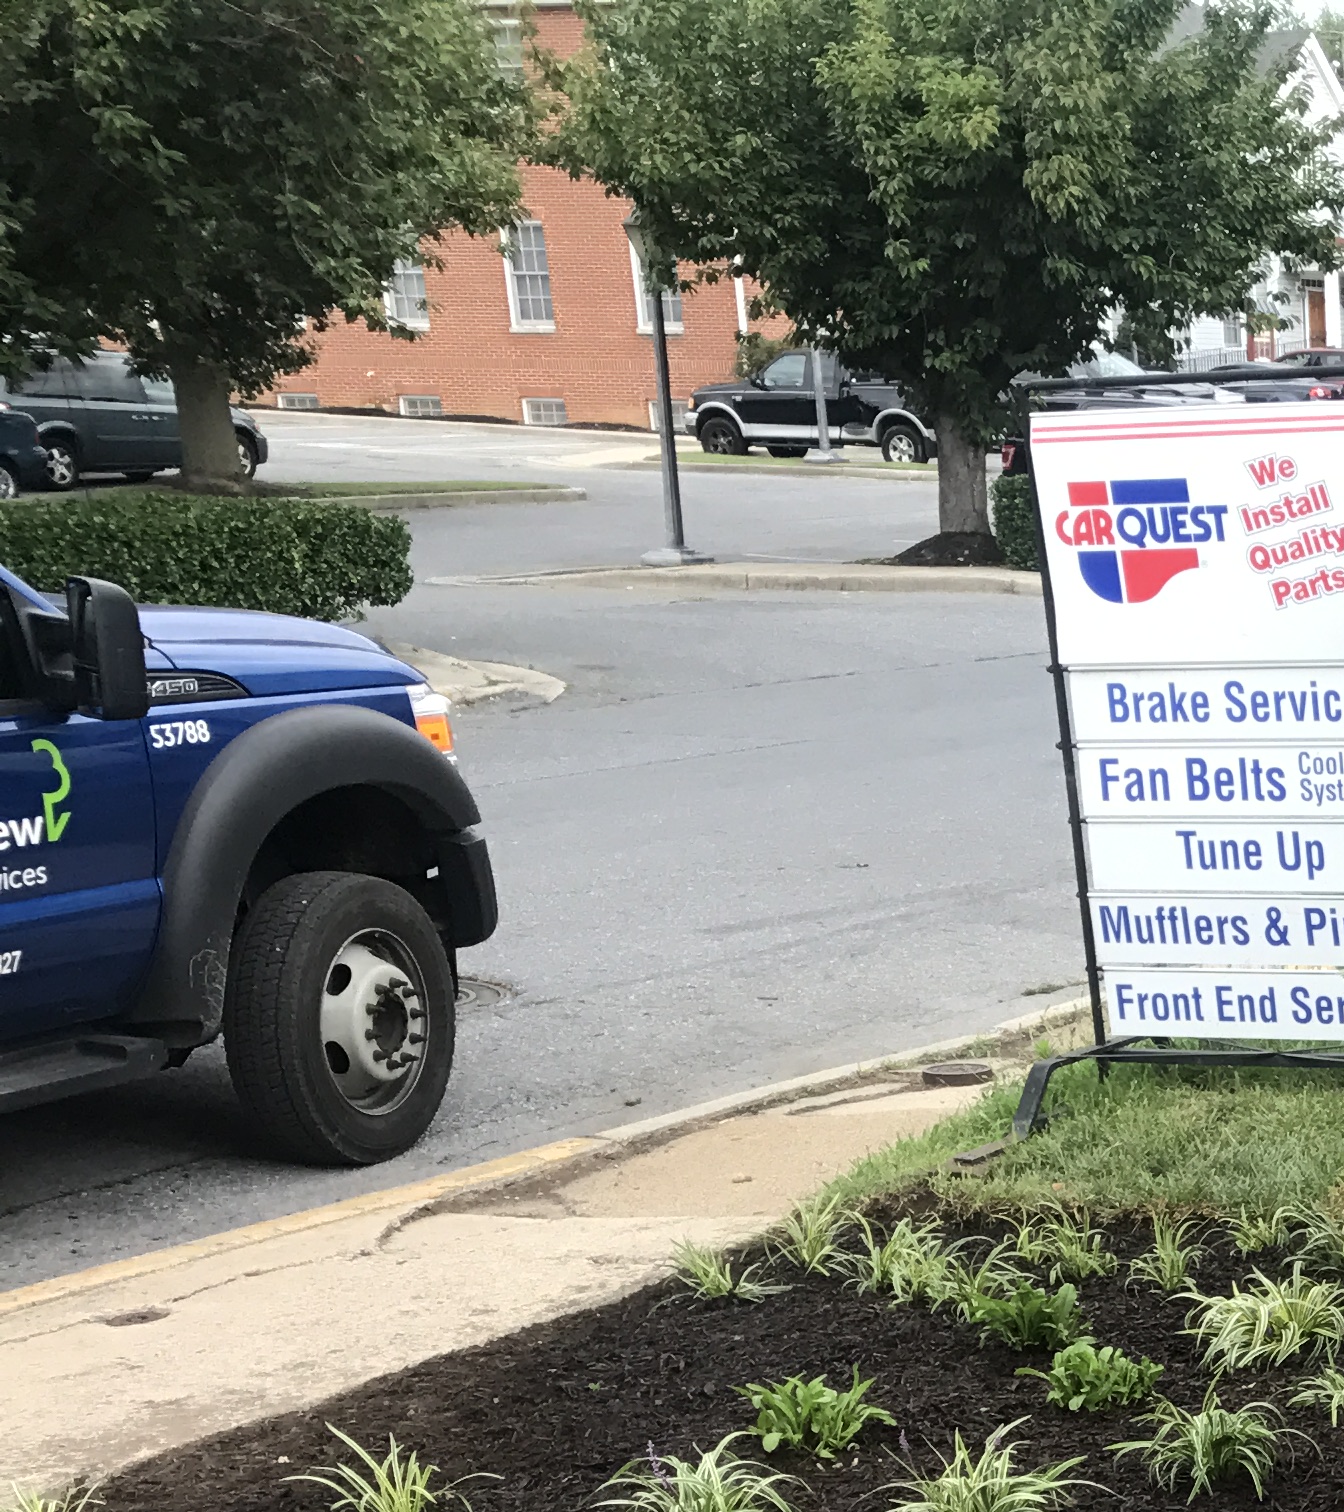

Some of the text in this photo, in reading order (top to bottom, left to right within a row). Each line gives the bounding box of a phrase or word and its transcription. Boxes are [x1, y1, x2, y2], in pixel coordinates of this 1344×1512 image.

[1248, 456, 1297, 487] We
[1055, 503, 1228, 548] CARQUEST
[1241, 485, 1330, 532] Install
[1106, 682, 1210, 723] Brake
[149, 719, 211, 749] 53788
[1099, 757, 1287, 801] Fan Belts
[1175, 830, 1325, 880] Tune Up
[1099, 905, 1250, 946] Mufflers
[1265, 906, 1291, 947] &
[1115, 984, 1202, 1022] Front
[1214, 985, 1278, 1023] End
